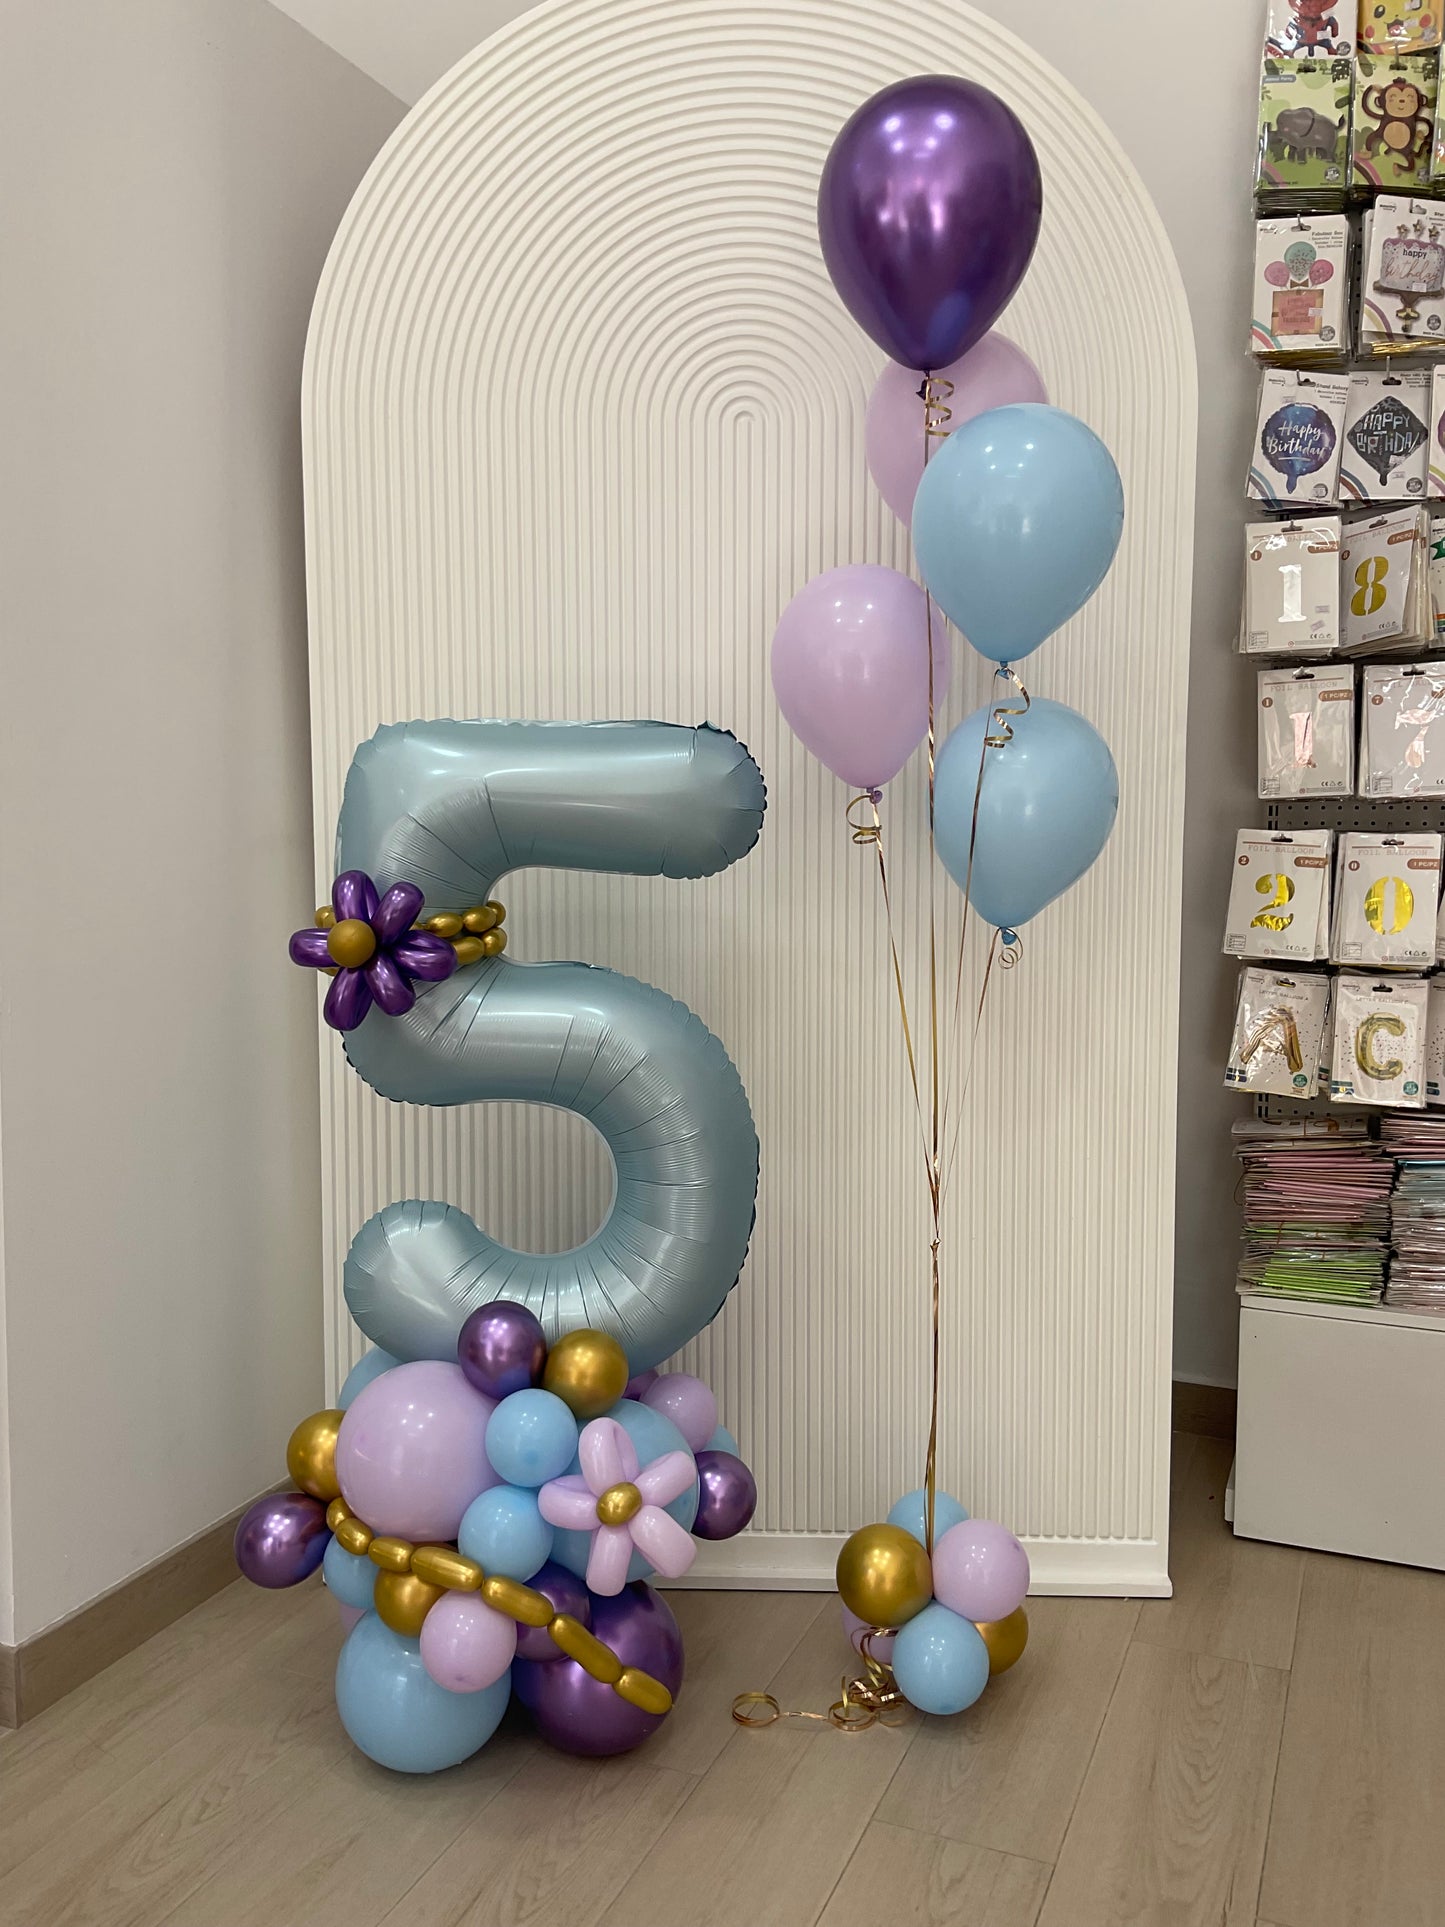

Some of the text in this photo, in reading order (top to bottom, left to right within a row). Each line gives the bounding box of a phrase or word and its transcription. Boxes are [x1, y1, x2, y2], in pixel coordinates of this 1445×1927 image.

[1385, 257, 1440, 283] birthday
[1402, 249, 1427, 259] happy
[1268, 436, 1325, 460] Birthday
[1278, 420, 1325, 442] Happy
[1363, 412, 1410, 431] HAPPY
[1278, 563, 1307, 623] 1
[1350, 556, 1389, 616] 8
[1289, 711, 1316, 768] 1
[1395, 708, 1437, 768] 7
[1250, 873, 1296, 932] 2
[1364, 875, 1415, 935] 0
[1239, 1004, 1304, 1075] A
[1355, 1011, 1407, 1081] C
